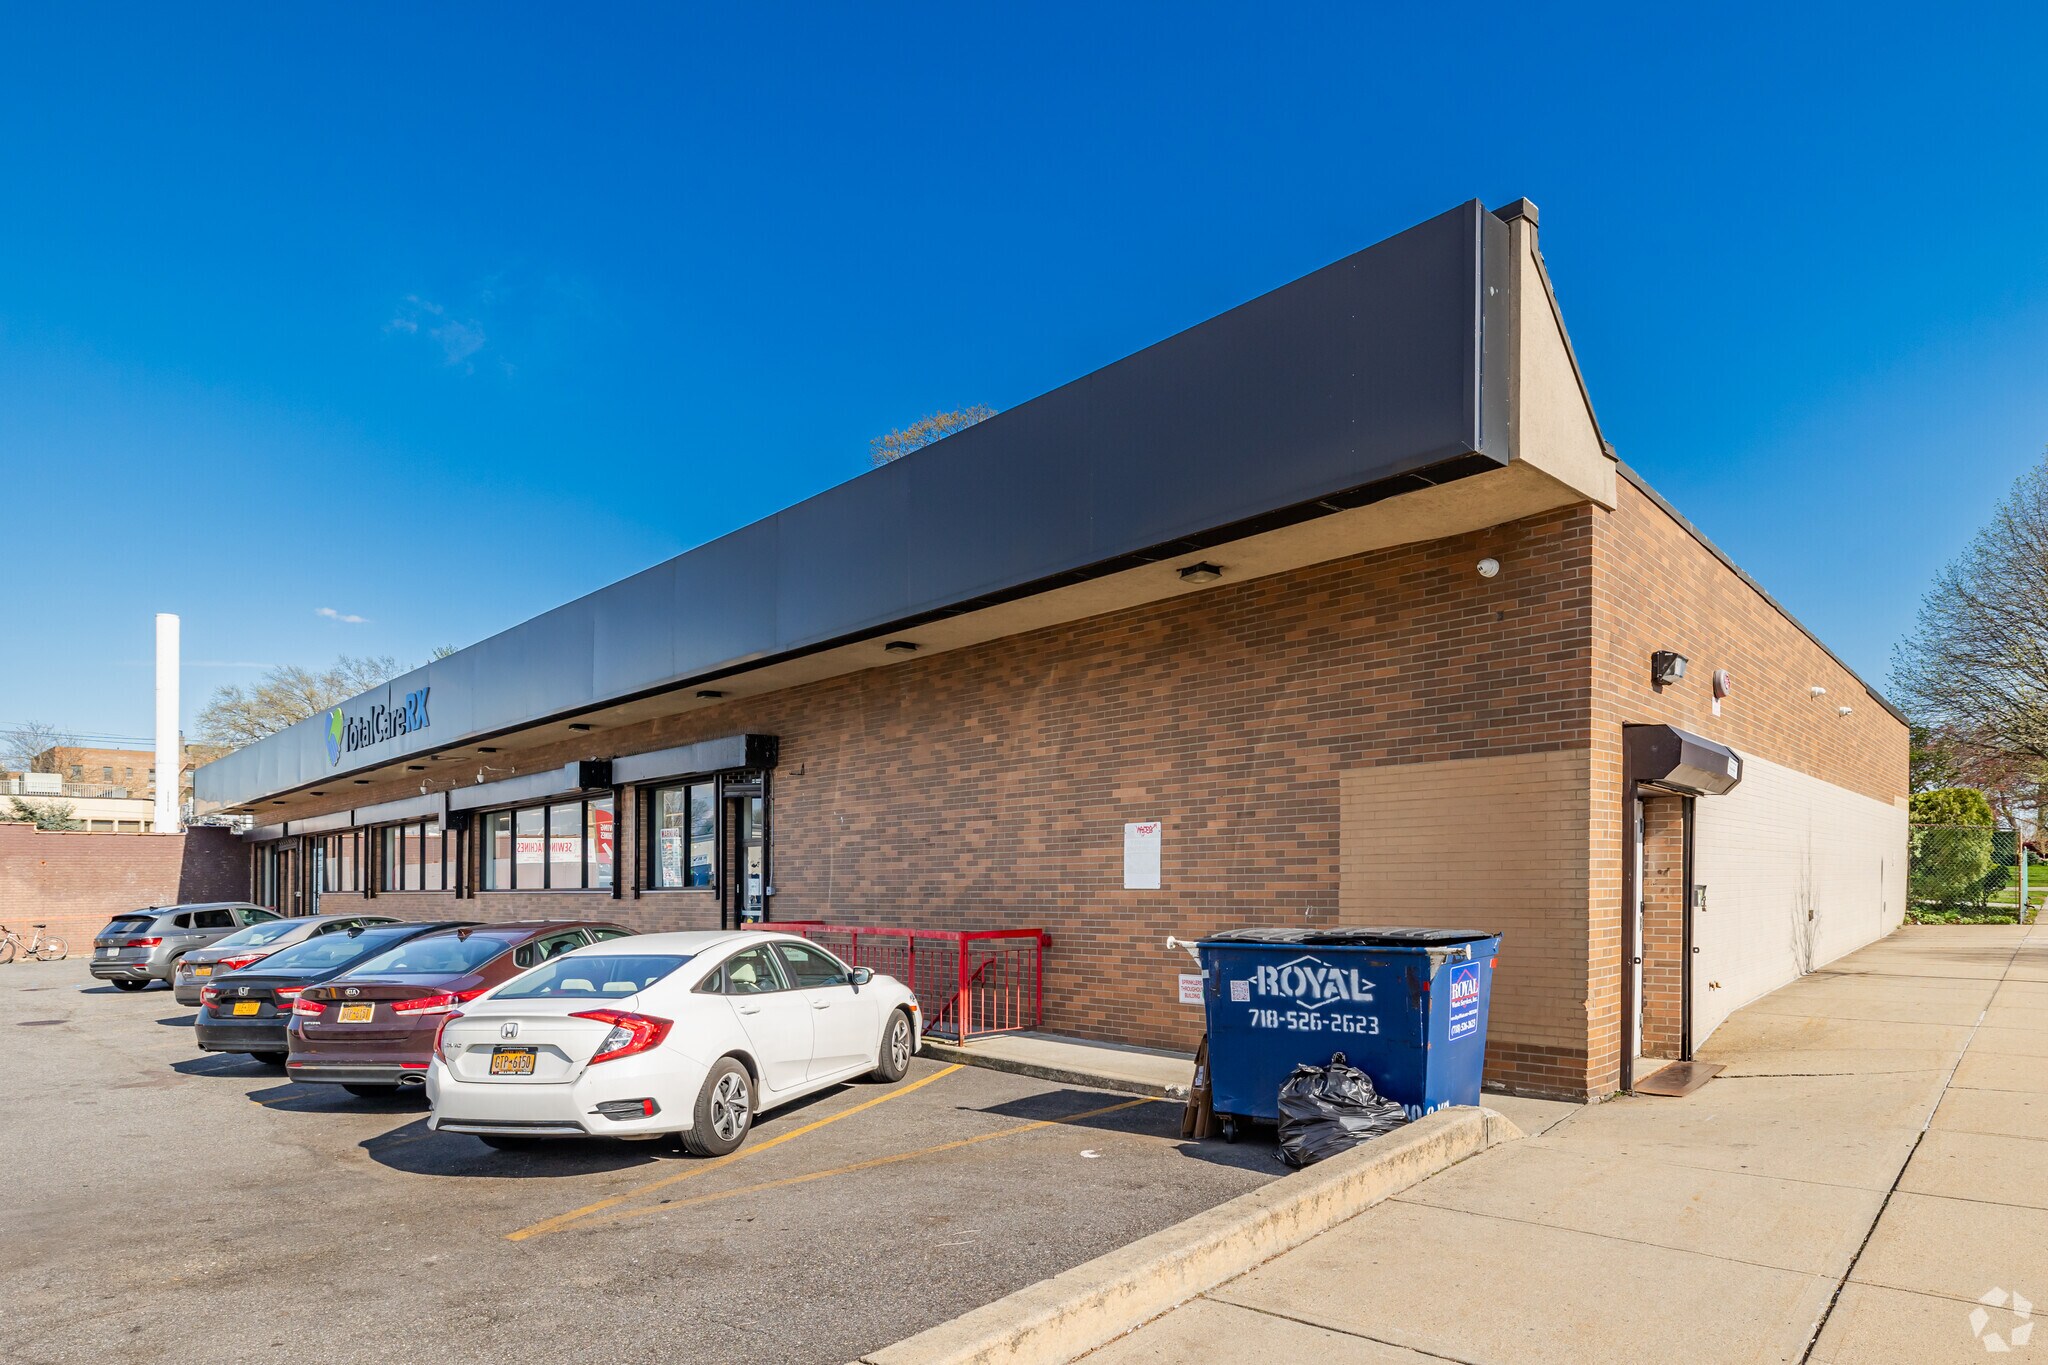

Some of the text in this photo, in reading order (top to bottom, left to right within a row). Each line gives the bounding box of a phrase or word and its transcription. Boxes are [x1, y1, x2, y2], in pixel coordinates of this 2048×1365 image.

[345, 686, 431, 753] TotalCareRX
[1257, 965, 1374, 1001] ROYAL
[1452, 979, 1478, 999] ROYAL
[1248, 1008, 1380, 1035] 718-526-2623
